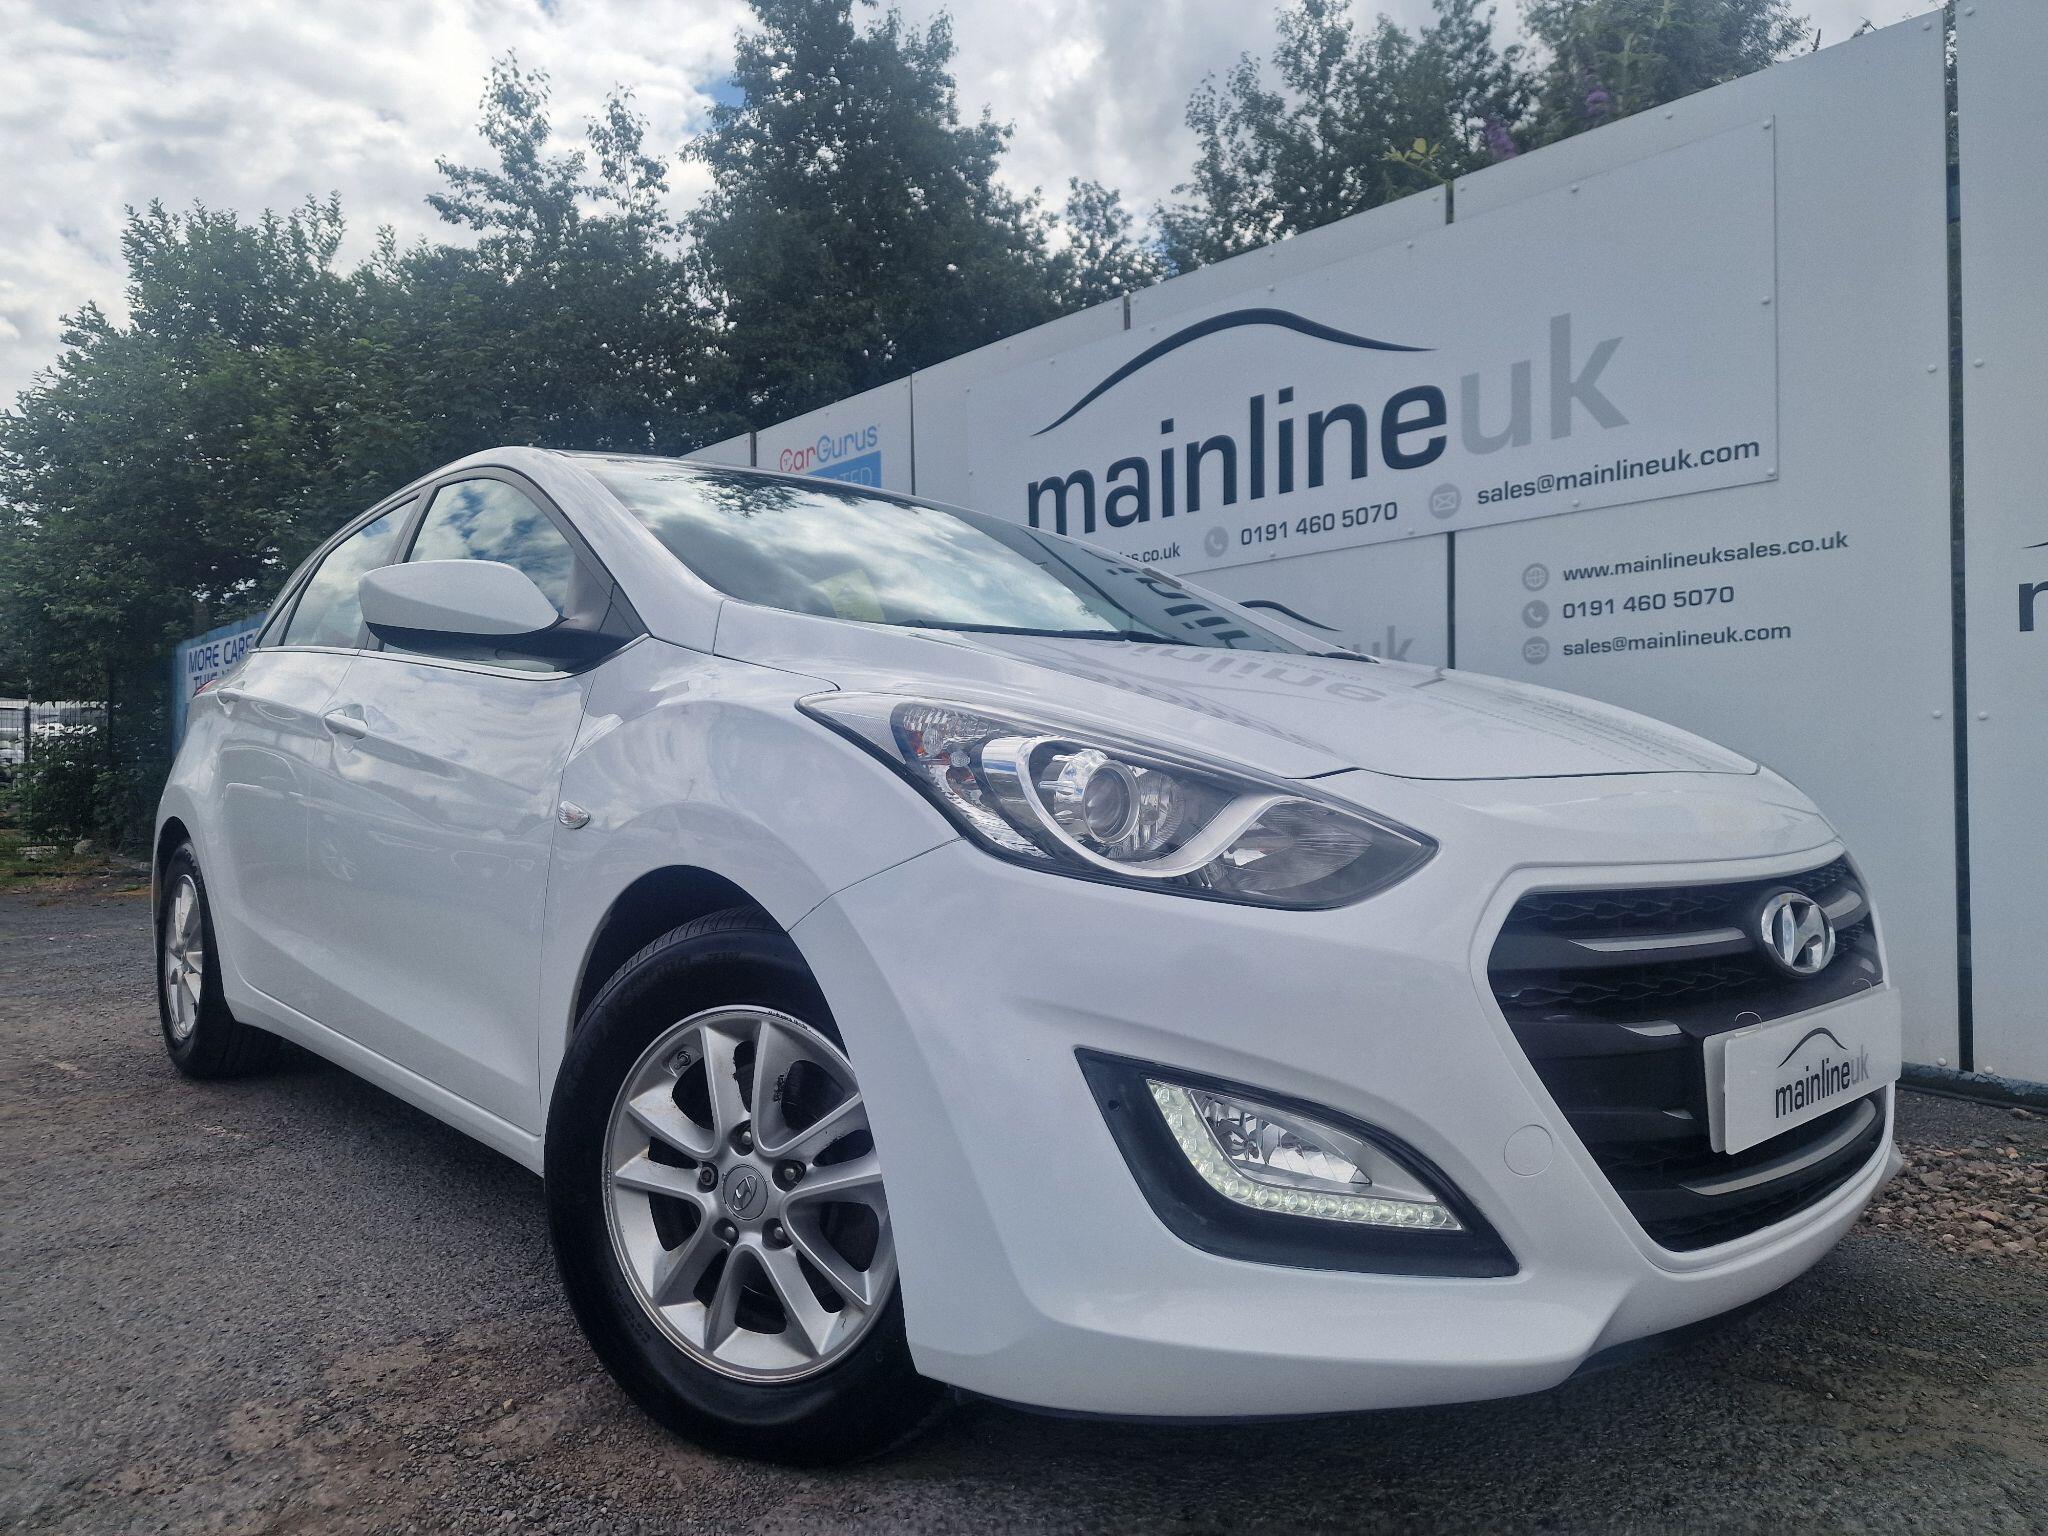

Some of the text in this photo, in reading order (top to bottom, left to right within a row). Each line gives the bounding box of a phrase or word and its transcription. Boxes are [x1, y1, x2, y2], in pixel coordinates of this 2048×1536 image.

[779, 424, 879, 472] CarGurus
[1028, 312, 1630, 537] mainlineuk
[1477, 440, 1760, 504] sales@mainlineuk.com
[1240, 501, 1398, 546] 0191 460 5070
[1562, 531, 1849, 582] www.mainlineuksales.co.uk
[1562, 585, 1735, 619] 0191 460 5070
[188, 644, 219, 674] MORE
[1562, 624, 1792, 656] sales@mainlineuk.com
[1775, 1045, 1869, 1118] mainlineuk
